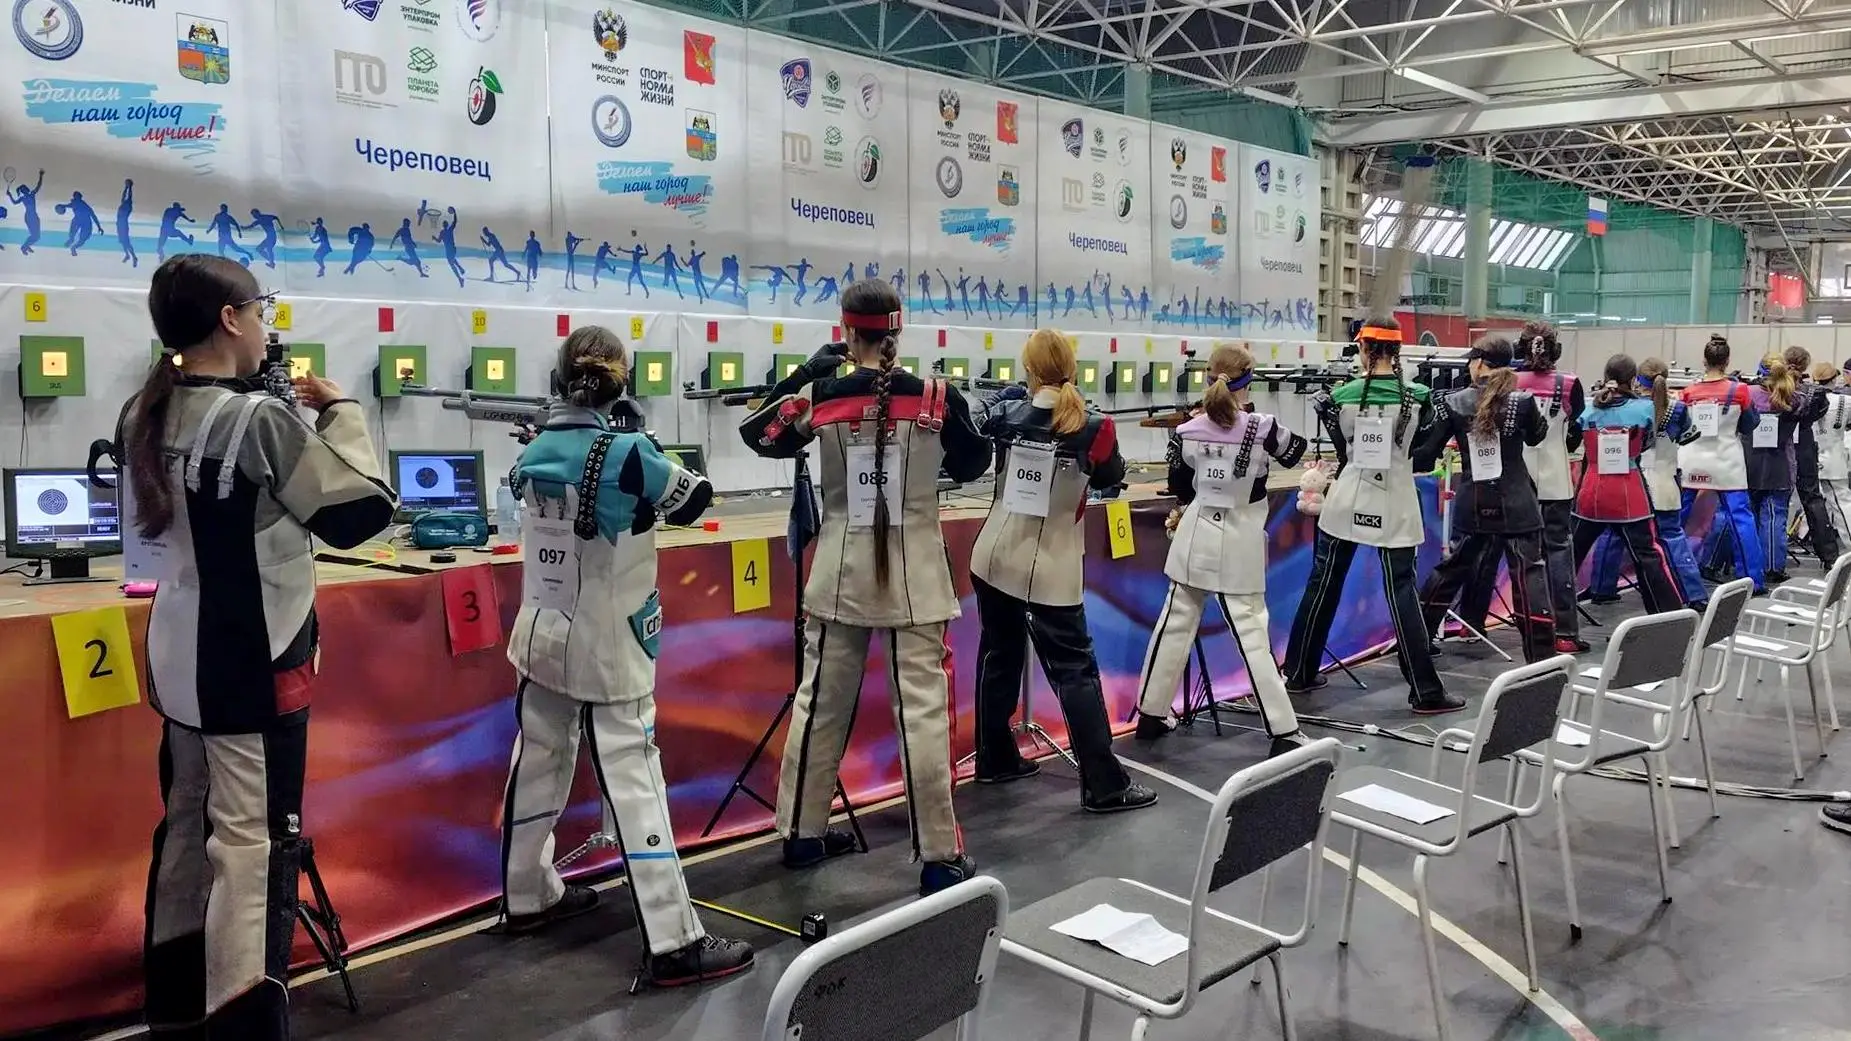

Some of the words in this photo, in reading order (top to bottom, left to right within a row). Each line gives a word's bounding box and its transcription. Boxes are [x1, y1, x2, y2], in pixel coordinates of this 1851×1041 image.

[400, 5, 441, 20] ЭНТЕРПРОМ
[403, 13, 438, 26] УПАКОВКА
[334, 49, 387, 95] ГТО
[591, 62, 629, 77] МИНСПОРТ
[407, 77, 439, 88] ПЛАНЕТА
[597, 75, 626, 86] РОССИИ
[640, 80, 674, 95] НОРМА
[34, 80, 121, 103] Делаем
[408, 84, 439, 95] КОРОБОК
[640, 91, 674, 107] ЖИЗНИ
[71, 108, 120, 122] наш
[127, 102, 183, 126] город
[141, 116, 216, 147] лучше!
[355, 138, 492, 181] Череповец
[623, 179, 651, 193] наш
[655, 175, 689, 194] город
[791, 197, 875, 229] Череповец
[1068, 231, 1128, 255] Череповец
[32, 300, 41, 312] 6
[279, 310, 286, 321] 8
[474, 317, 486, 327] 10
[1361, 433, 1384, 443] 086
[1604, 447, 1622, 455] 096
[1017, 468, 1042, 482] 068
[1207, 468, 1225, 479] 105
[660, 476, 690, 509] СПБ
[1354, 513, 1382, 527] МСК
[1116, 518, 1127, 539] 6
[538, 548, 566, 565] 097
[744, 560, 758, 586] 4
[461, 590, 481, 623] 3
[84, 639, 113, 679] 2
